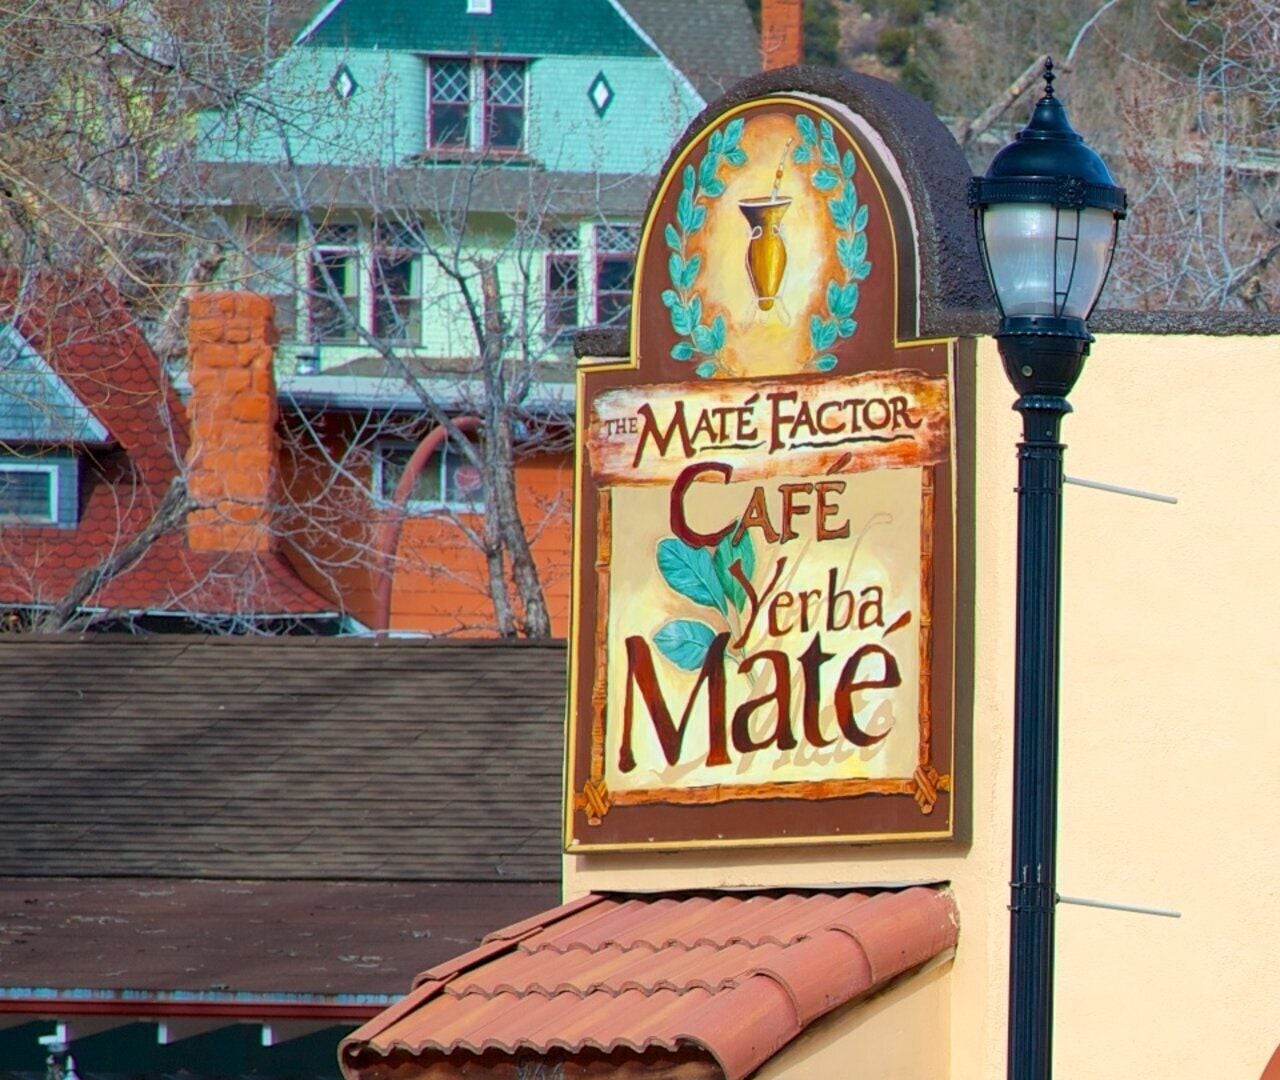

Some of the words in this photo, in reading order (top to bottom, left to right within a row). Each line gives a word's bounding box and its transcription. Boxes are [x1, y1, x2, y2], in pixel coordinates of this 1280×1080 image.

[767, 391, 922, 454] FACTOR
[728, 557, 886, 651] Yerba
[618, 611, 912, 774] Maté
